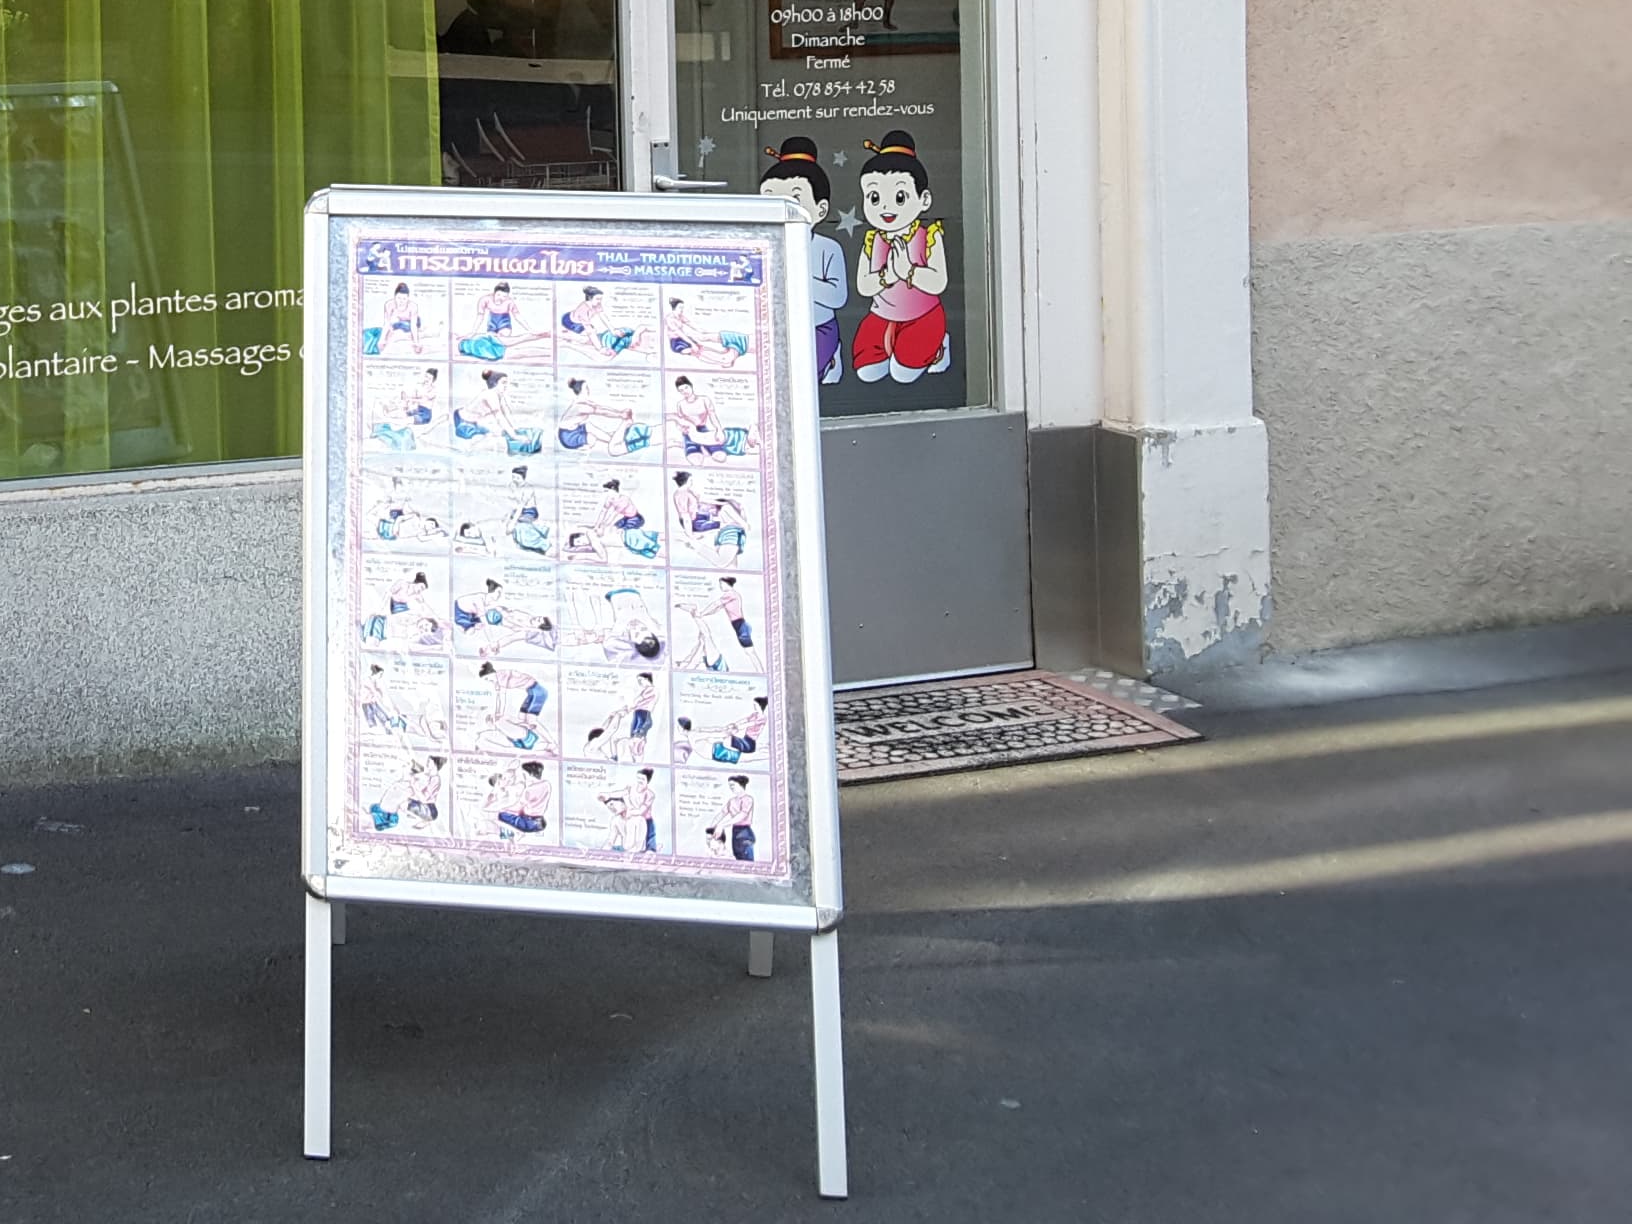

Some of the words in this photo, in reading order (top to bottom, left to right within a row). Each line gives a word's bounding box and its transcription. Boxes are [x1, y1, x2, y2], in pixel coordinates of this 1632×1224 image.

[771, 4, 823, 26] 09h00
[826, 8, 836, 22] à
[839, 3, 884, 22] 18h00
[791, 27, 865, 48] Dimanche
[806, 55, 851, 70] Fermé
[761, 79, 790, 98] Tél.
[793, 81, 822, 99] 078
[855, 79, 877, 94] 42
[878, 78, 896, 97] 58
[721, 105, 813, 130] Uniquement
[815, 107, 838, 119] sur
[843, 98, 935, 118] rendez-vous
[639, 252, 729, 265] TRADITIONAL
[633, 265, 694, 277] MASSAGE
[49, 300, 103, 321] aux
[111, 282, 218, 333] plantes
[149, 343, 291, 376] Massages
[843, 704, 1055, 739] WELCOME
